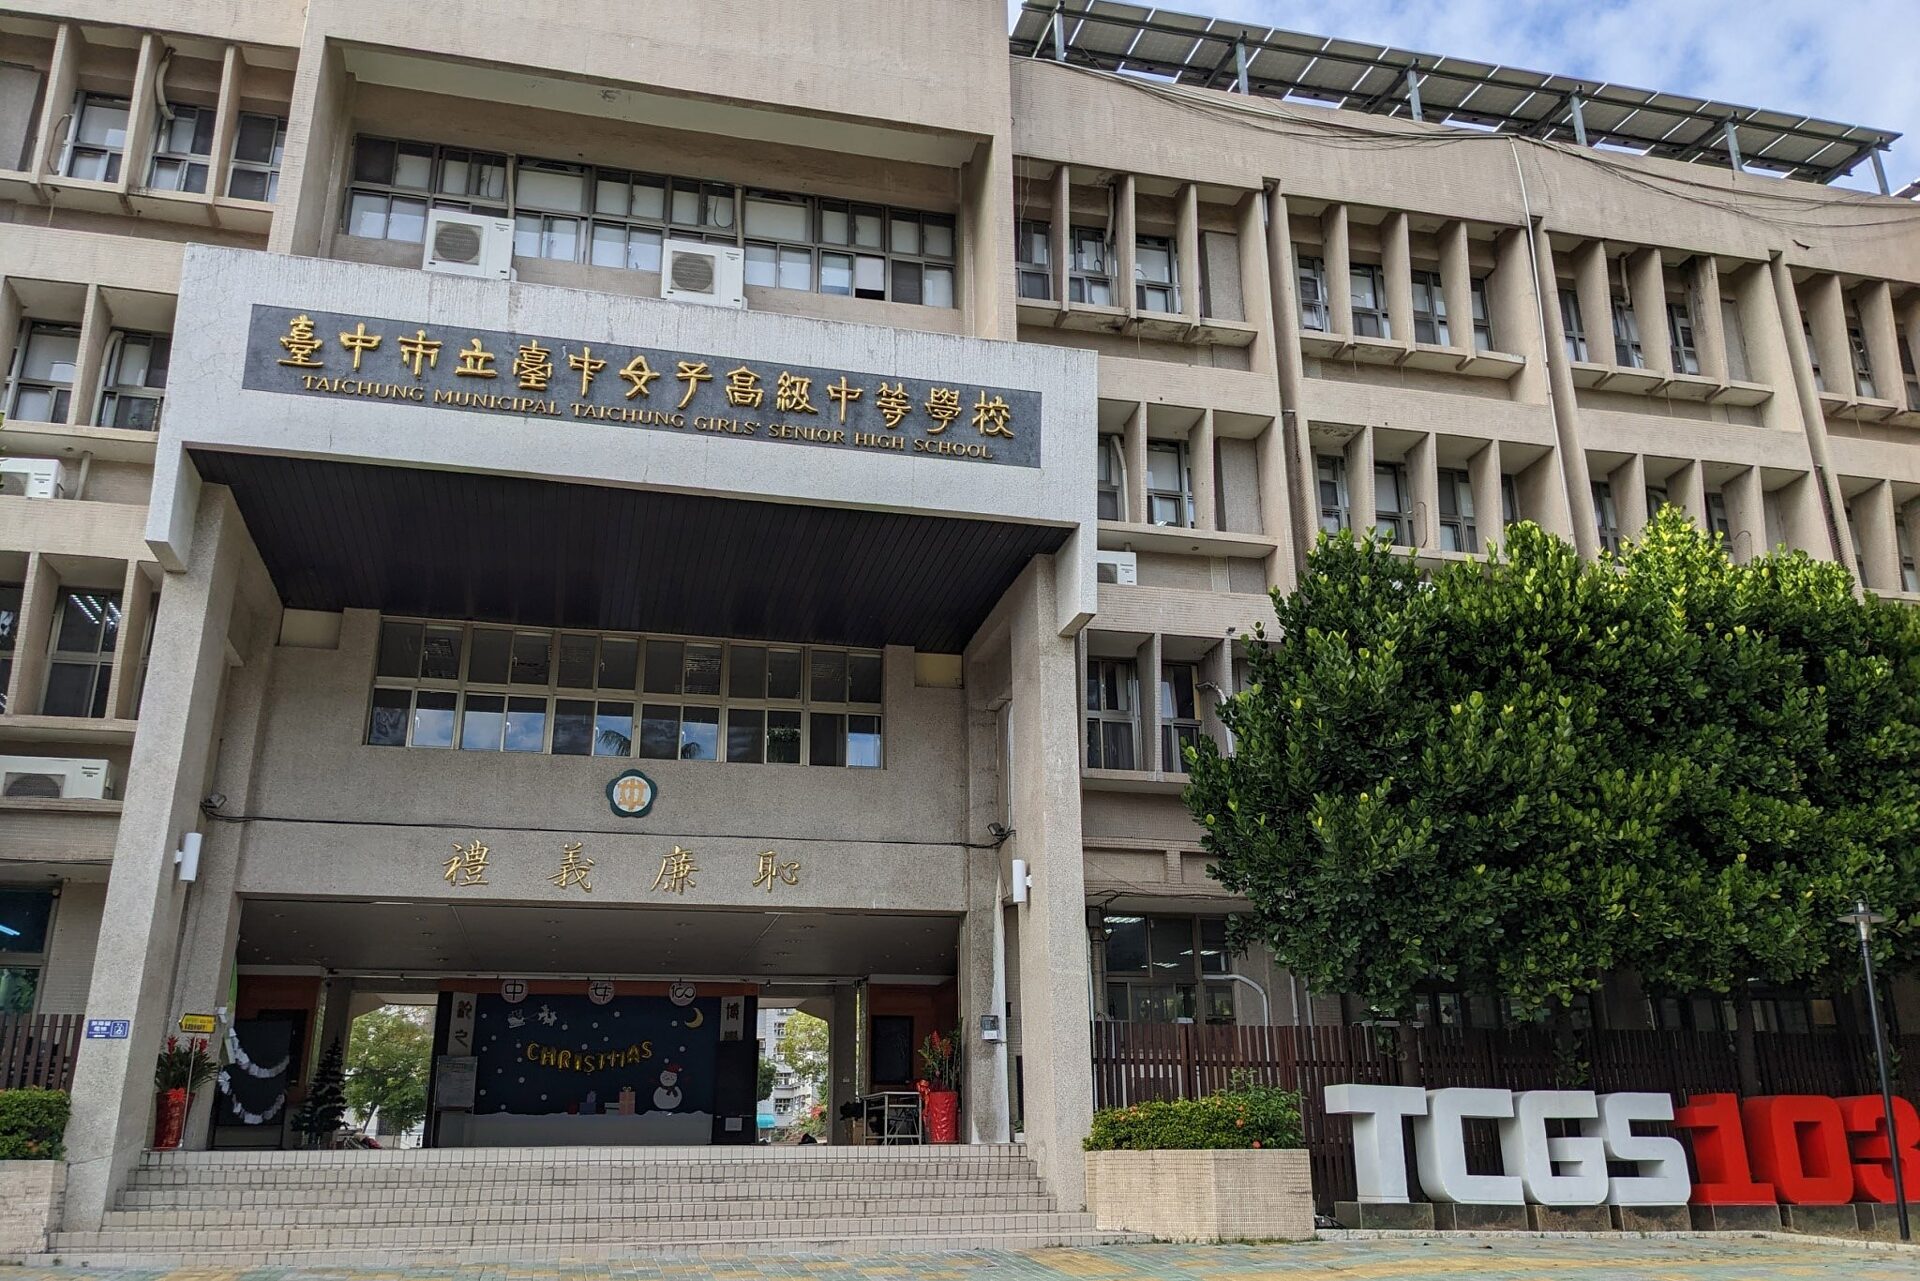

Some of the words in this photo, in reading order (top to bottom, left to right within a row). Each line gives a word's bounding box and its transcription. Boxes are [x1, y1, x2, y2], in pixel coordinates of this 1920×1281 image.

[276, 314, 1015, 439] 臺中市立臺中女子高級中等學校
[301, 374, 425, 402] TAICHUNG
[433, 388, 562, 417] MUNICIPAL
[571, 402, 685, 429] TAICHUNG
[768, 423, 846, 445] SENIOR
[854, 432, 906, 451] HIGH
[913, 438, 994, 460] SCHOOL
[442, 838, 801, 894] 禮義廉恥
[526, 1040, 653, 1073] CHRISTMAS
[1324, 1084, 1692, 1206] TCGS
